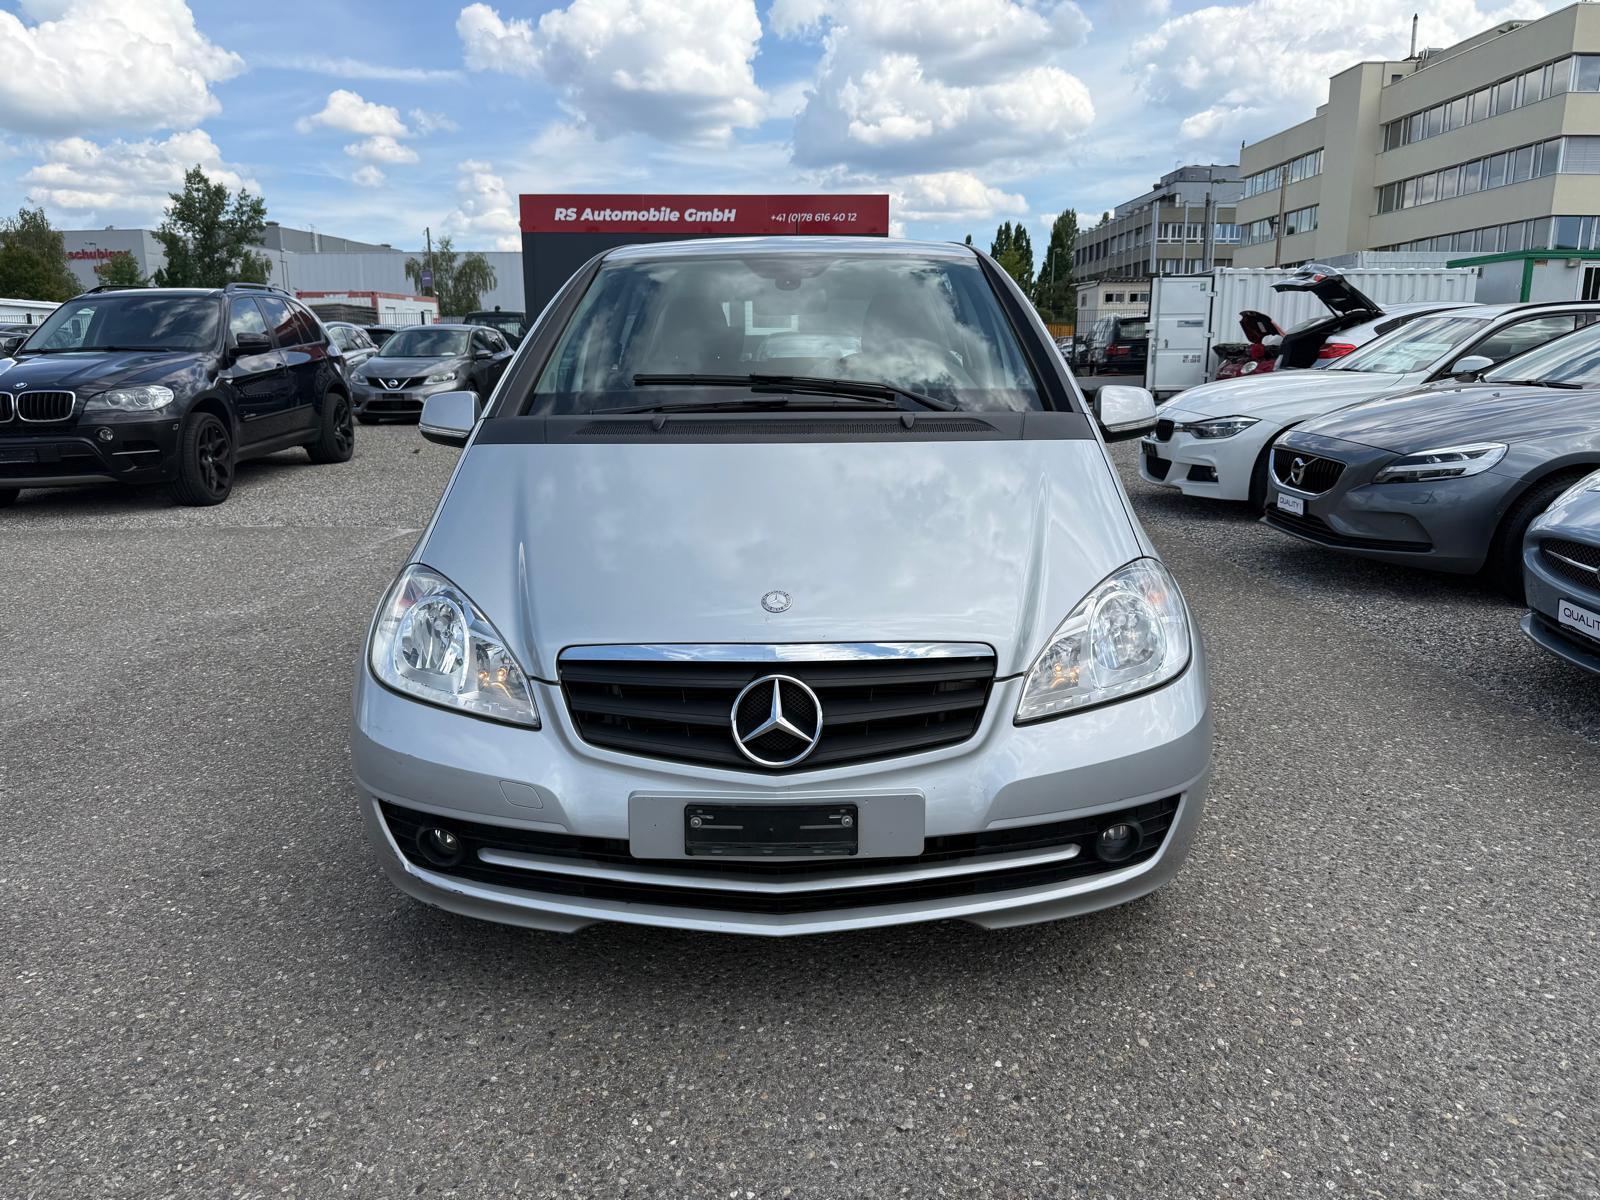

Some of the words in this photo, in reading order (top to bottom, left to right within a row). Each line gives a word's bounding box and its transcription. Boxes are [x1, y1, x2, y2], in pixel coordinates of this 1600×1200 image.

[554, 208, 577, 221] RS
[580, 207, 680, 222] Automobile
[684, 209, 737, 222] GmbH
[771, 213, 786, 222] +41
[788, 213, 813, 223] (0)78
[814, 213, 831, 222] 616
[832, 213, 846, 222] 40
[847, 213, 857, 222] 12
